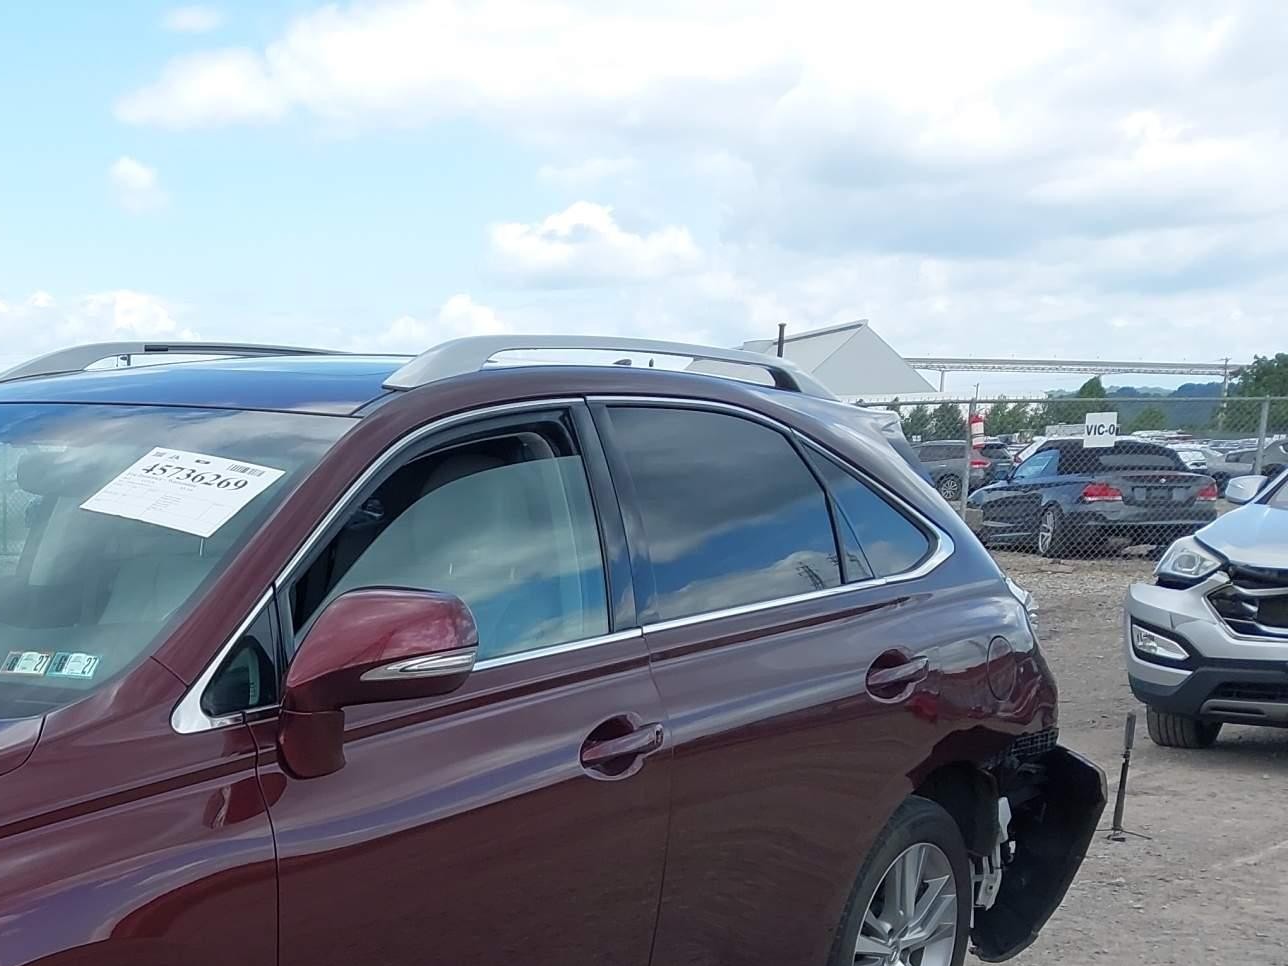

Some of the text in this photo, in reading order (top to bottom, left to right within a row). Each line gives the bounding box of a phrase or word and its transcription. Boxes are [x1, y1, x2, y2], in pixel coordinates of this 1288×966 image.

[142, 462, 249, 491] 45736269
[33, 655, 50, 673] 27
[81, 656, 98, 675] 27
